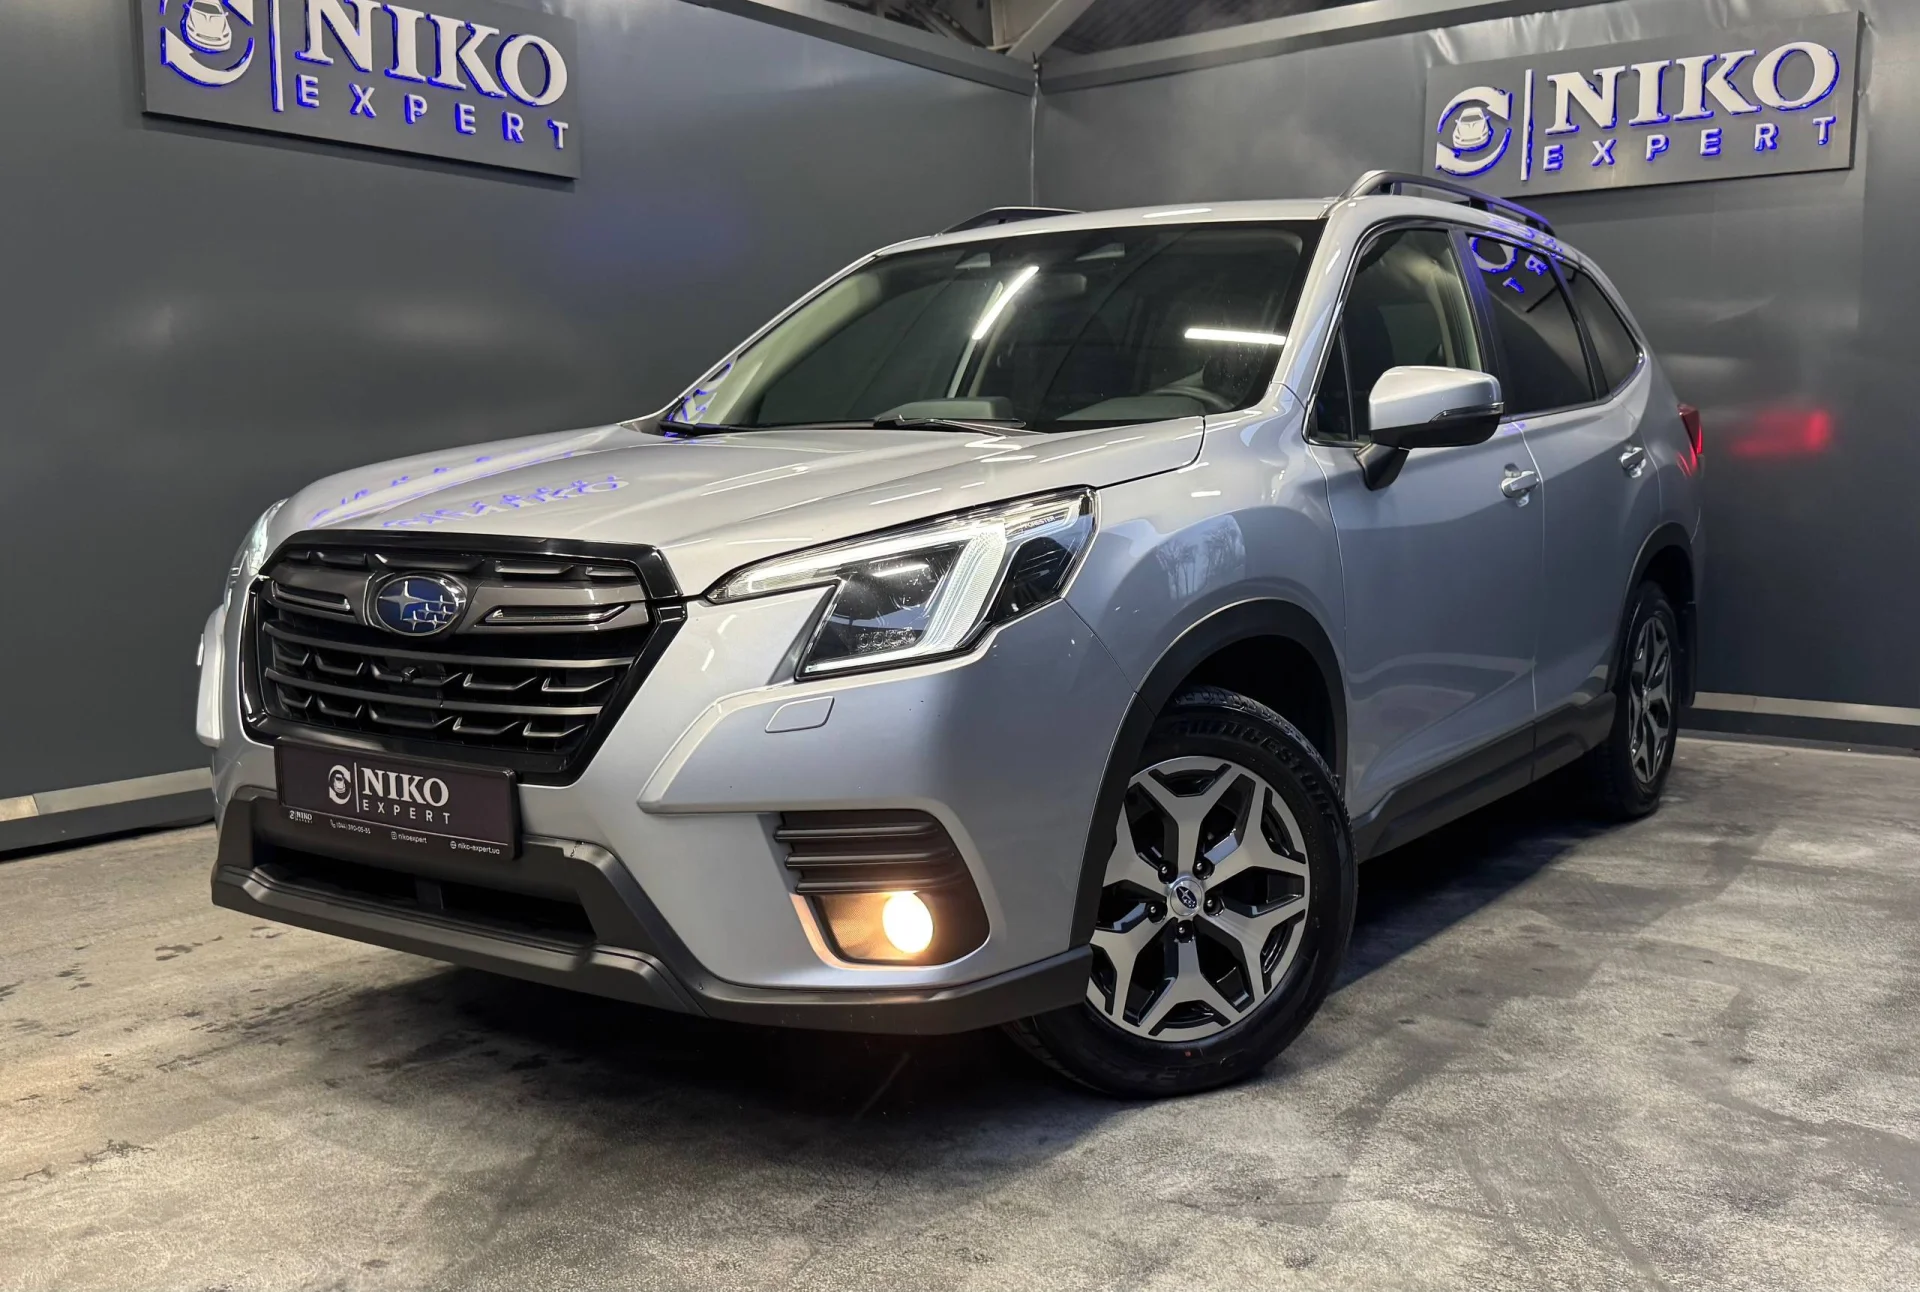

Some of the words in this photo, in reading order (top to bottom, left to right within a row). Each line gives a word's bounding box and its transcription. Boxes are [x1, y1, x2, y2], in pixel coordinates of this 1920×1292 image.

[295, 0, 568, 107] NIKO
[295, 74, 569, 150] EXPERT
[1545, 41, 1840, 134] NIKO
[1543, 116, 1836, 172] EXPERT
[360, 767, 450, 807] NIKO
[362, 799, 451, 825] EXPERT
